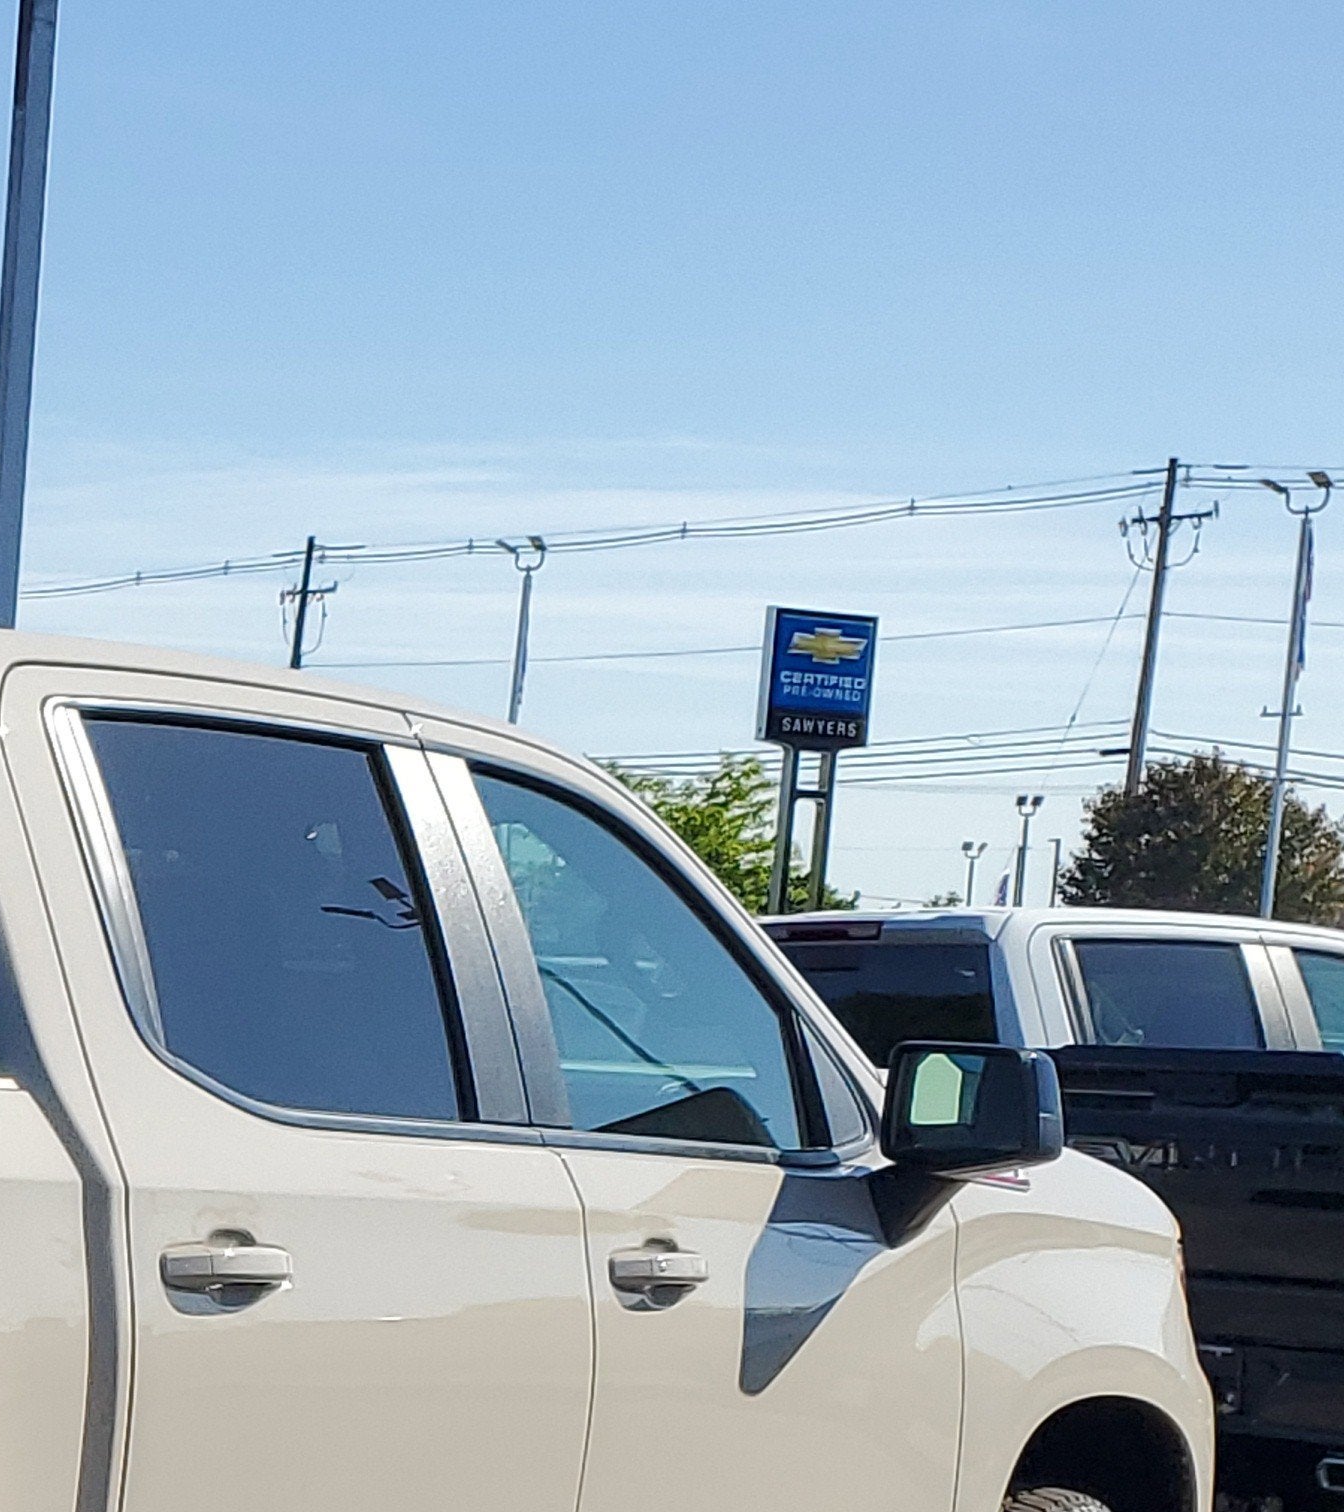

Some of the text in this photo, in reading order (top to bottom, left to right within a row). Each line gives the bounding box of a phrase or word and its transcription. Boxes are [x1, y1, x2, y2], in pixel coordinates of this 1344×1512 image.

[780, 671, 866, 689] CERTIFIED
[783, 684, 861, 701] PRE-OWNED
[782, 717, 857, 737] SAWYERS
